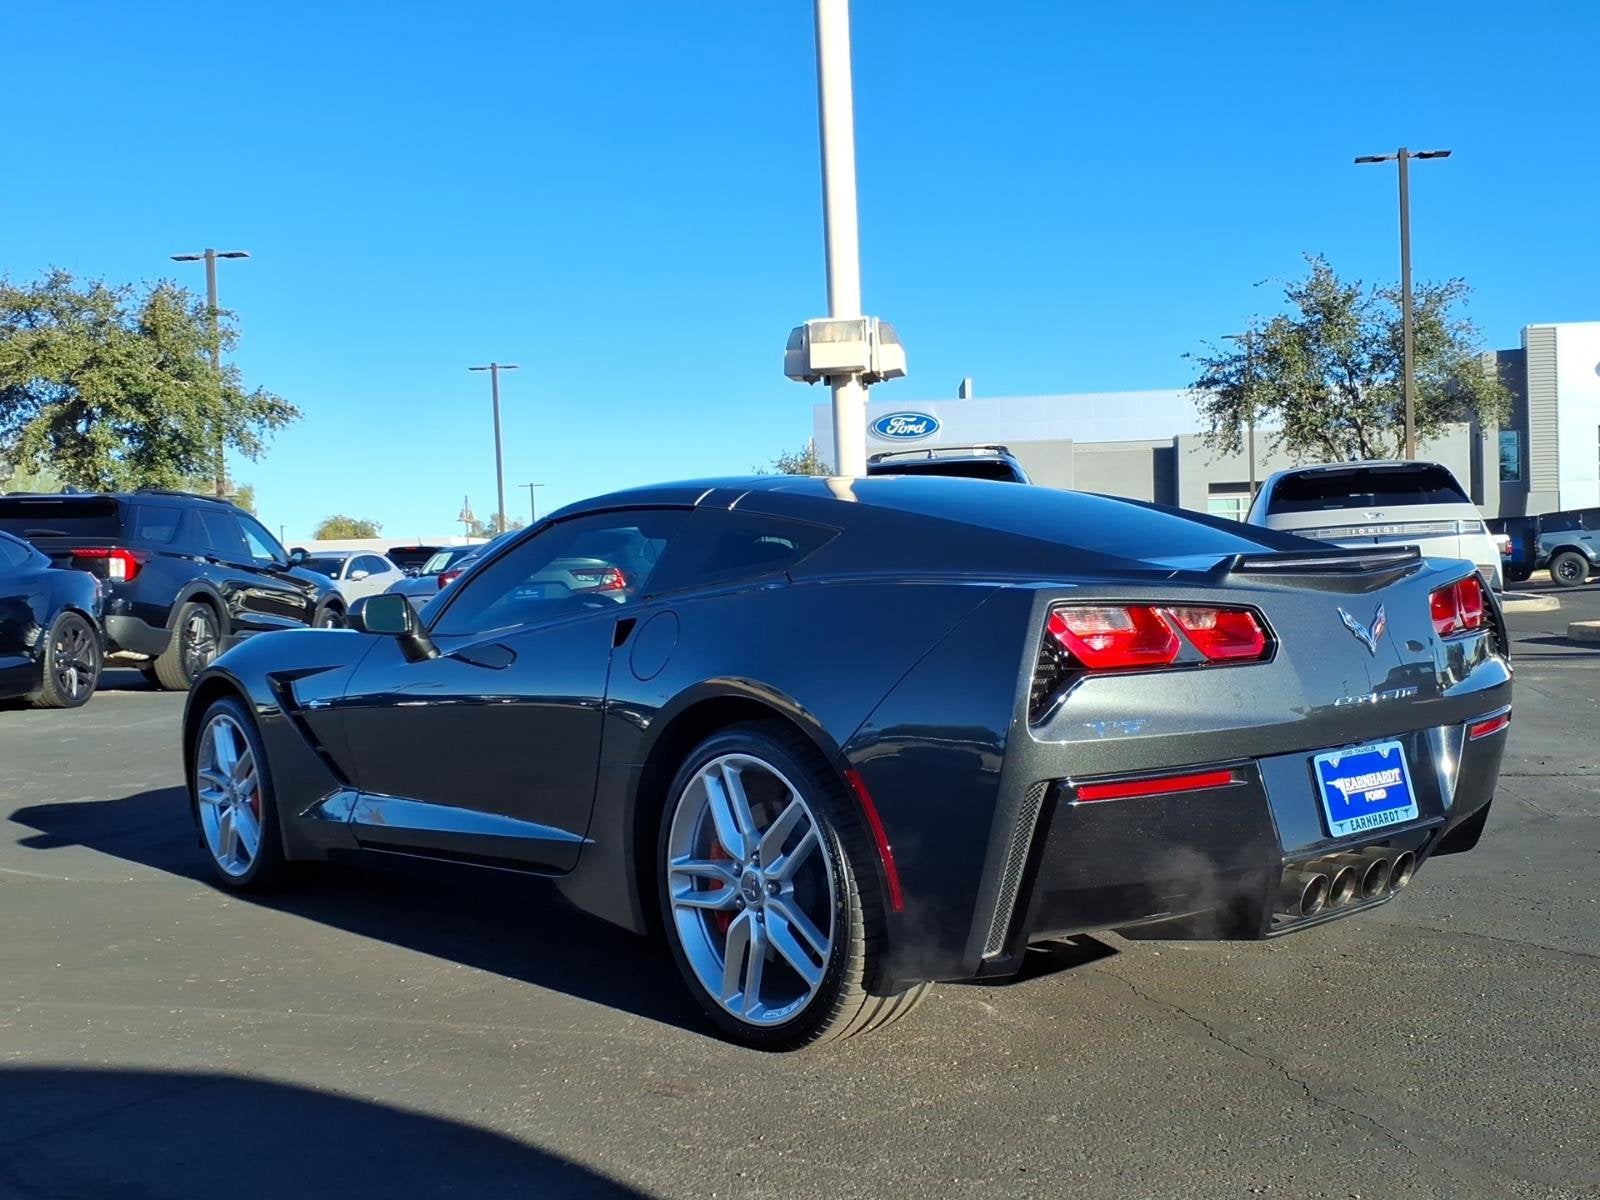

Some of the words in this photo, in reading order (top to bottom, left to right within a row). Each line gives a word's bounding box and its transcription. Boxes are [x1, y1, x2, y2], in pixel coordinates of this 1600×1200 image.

[886, 417, 928, 434] Ford
[1344, 767, 1400, 791] EARNHARDT
[1350, 810, 1400, 832] EARNHARDT
